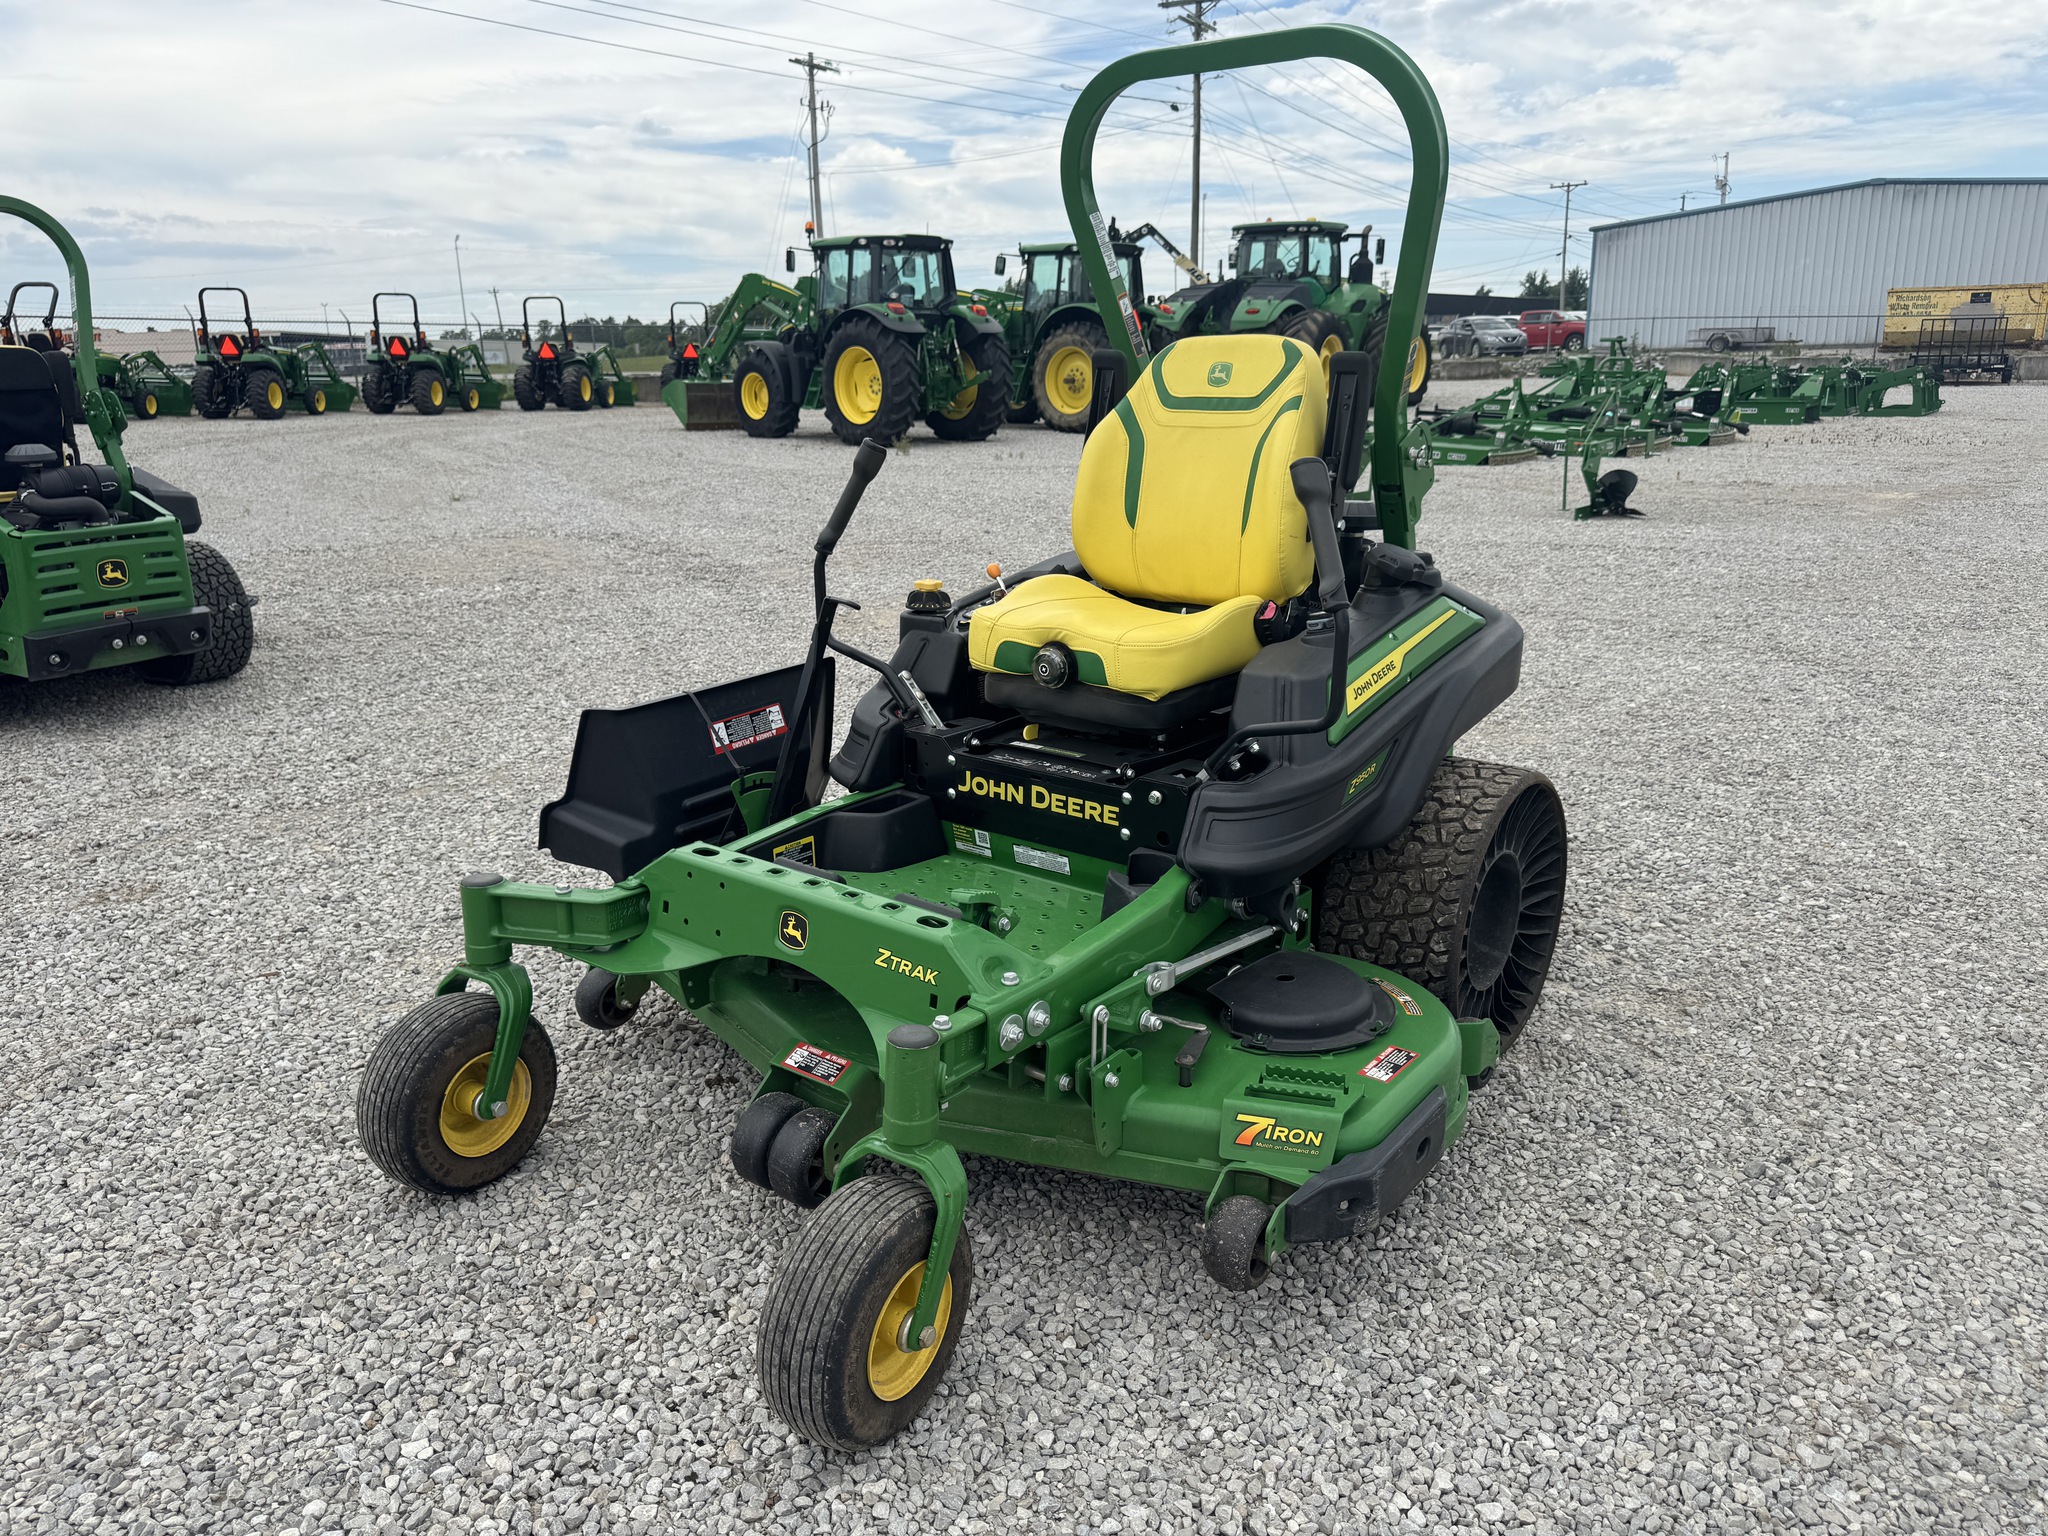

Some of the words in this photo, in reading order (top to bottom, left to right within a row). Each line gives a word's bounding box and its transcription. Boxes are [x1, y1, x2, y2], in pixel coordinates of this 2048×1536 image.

[1186, 267, 1204, 281] JLG
[1353, 677, 1373, 700] JOHN
[1371, 660, 1397, 687] DEERE
[1348, 763, 1377, 794] Z950R
[957, 771, 1024, 805] JOHN
[1031, 785, 1120, 827] DEERE
[1255, 1141, 1273, 1149] Mulch
[1284, 1145, 1309, 1154] Demand
